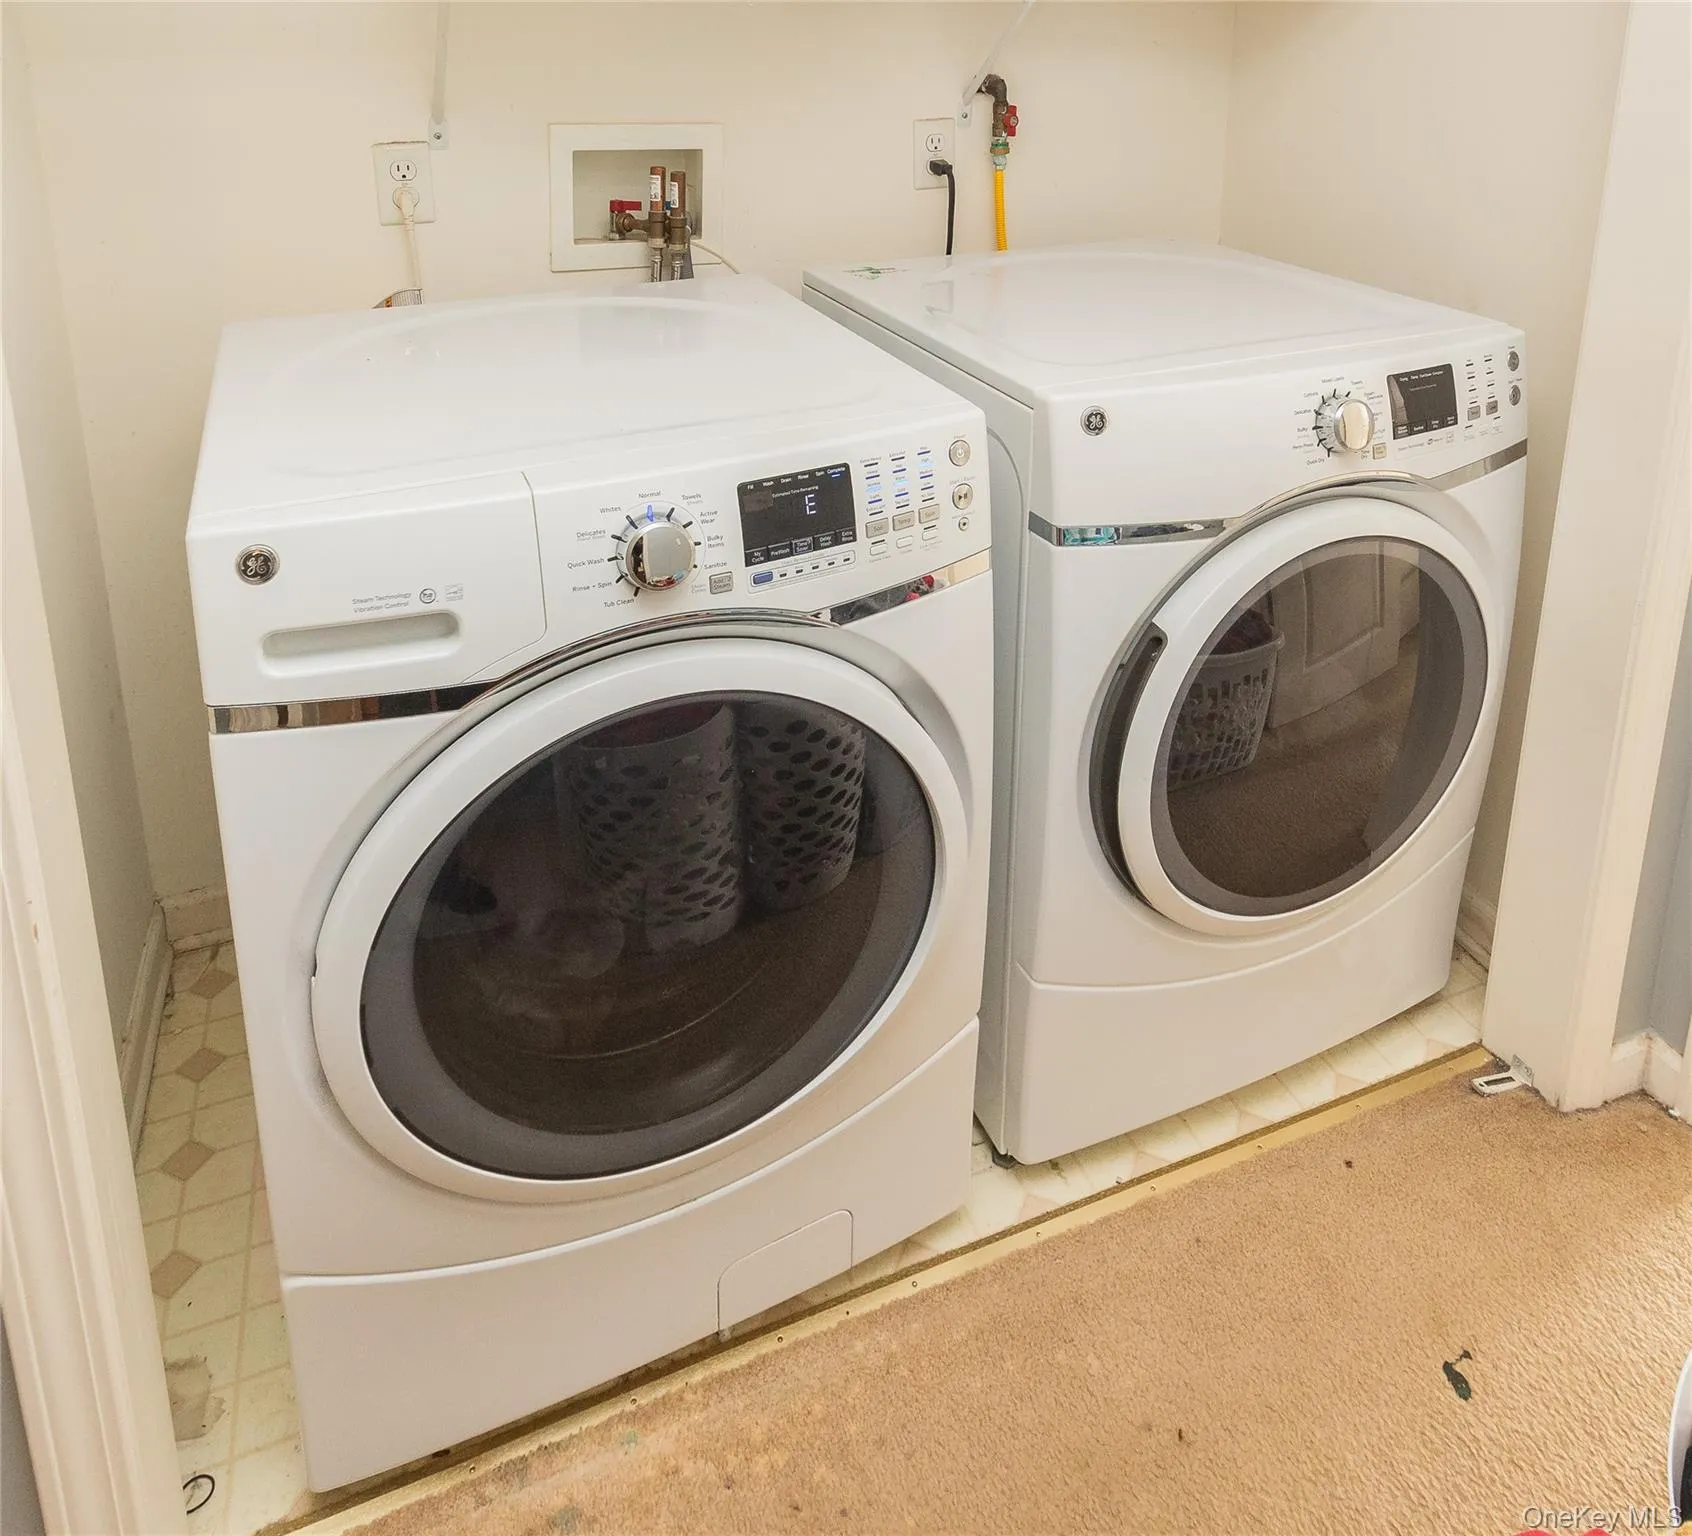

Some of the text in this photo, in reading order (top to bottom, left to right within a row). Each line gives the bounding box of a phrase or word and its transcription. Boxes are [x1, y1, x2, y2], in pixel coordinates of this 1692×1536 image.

[638, 490, 662, 499] Normal
[804, 493, 817, 515] E
[599, 505, 622, 515] Whites
[700, 510, 719, 518] Active
[701, 518, 716, 526] Wear
[576, 529, 607, 539] Delicates
[707, 535, 725, 544] Bulky
[707, 542, 726, 550] Items
[567, 557, 606, 570] Quick Wash
[751, 556, 765, 564] Cycle
[704, 562, 728, 570] Sanitize
[572, 585, 591, 593] Rinse
[597, 581, 614, 591] Spin
[375, 592, 412, 602] Technology
[384, 601, 409, 610] Control
[603, 598, 636, 609] Tub Clean
